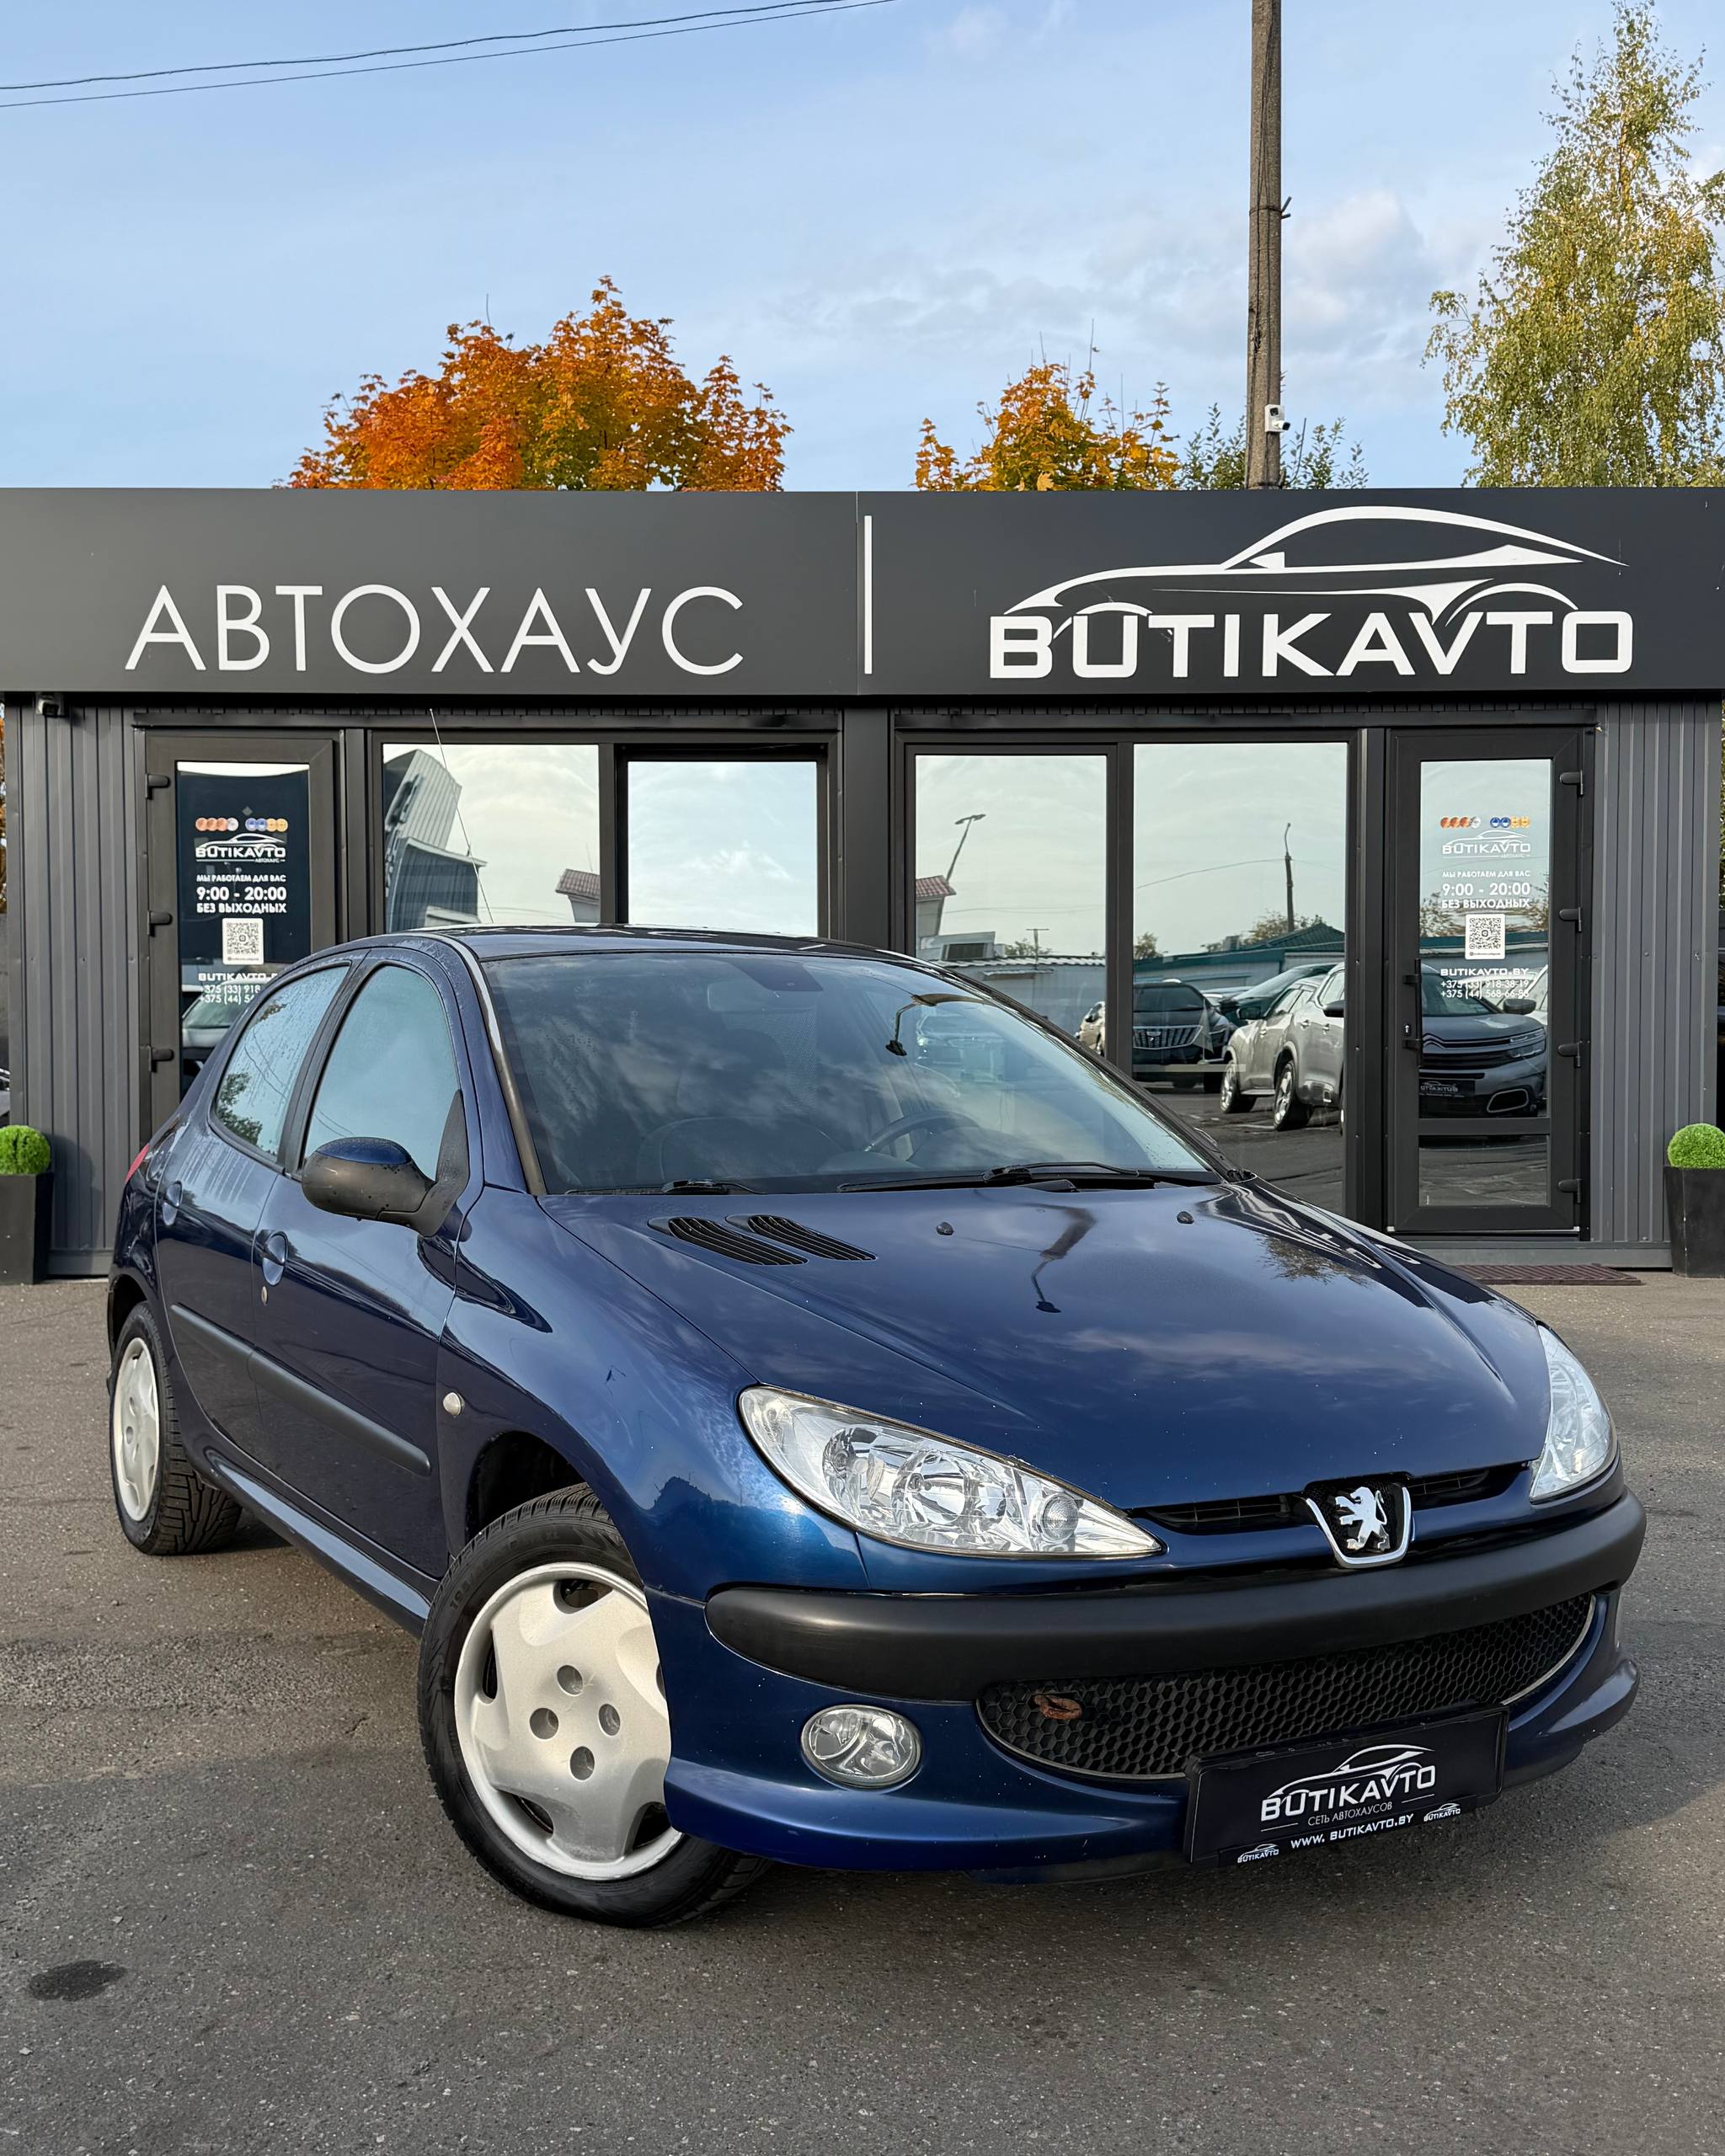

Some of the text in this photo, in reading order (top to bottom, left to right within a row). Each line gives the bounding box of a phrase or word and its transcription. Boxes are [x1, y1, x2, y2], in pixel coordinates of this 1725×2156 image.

[125, 584, 745, 675] АВТОХАУС
[990, 610, 1633, 679] BUTIKAVTO
[195, 846, 286, 857] BUTIKAVTO
[1442, 843, 1530, 854] BUTIKAVTO
[196, 887, 229, 900] 9:00
[244, 887, 286, 900] 20:00
[1442, 883, 1473, 896] 9:00
[1489, 883, 1530, 895] 20:00
[196, 903, 286, 914] БЕЗ ВЫХОДНЫХ
[1442, 899, 1530, 909] БЕЗ ВЫХОДНЫХ
[1440, 968, 1529, 976] BUTIKAVTO.BY
[223, 985, 241, 995] (33)
[1441, 980, 1462, 989] +375
[223, 995, 241, 1005] (44)
[1441, 990, 1462, 998] +375
[1260, 1765, 1435, 1822] BUTIKAVTO
[1307, 1801, 1393, 1827] СЕТЬ АВТОХАУСОВ
[1423, 1808, 1461, 1822] BUTIKAVTO
[1290, 1813, 1414, 1849] WWW. BUTIKAVTO.BY
[1237, 1849, 1279, 1864] BUTIKAVTO
